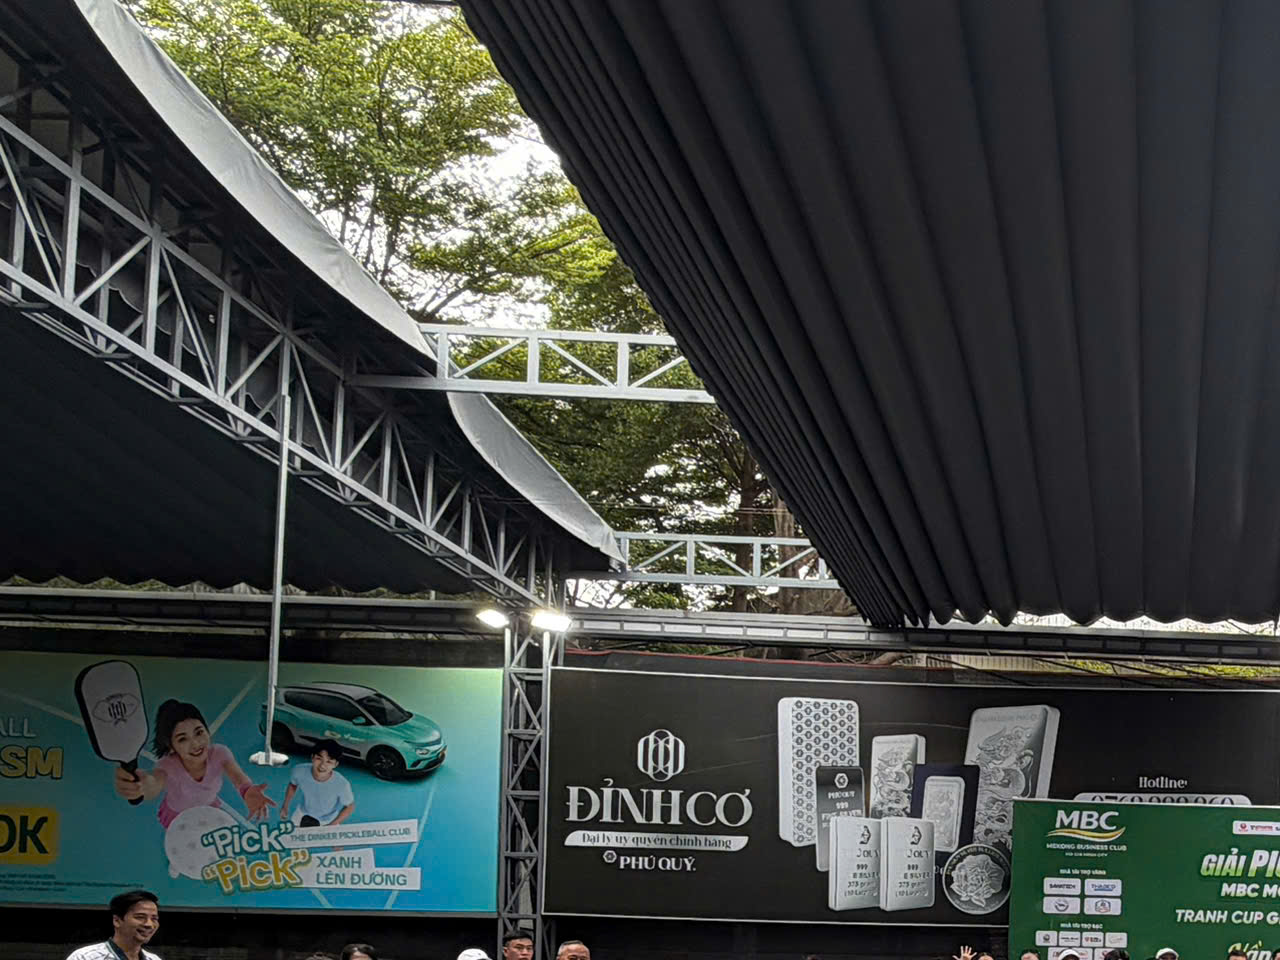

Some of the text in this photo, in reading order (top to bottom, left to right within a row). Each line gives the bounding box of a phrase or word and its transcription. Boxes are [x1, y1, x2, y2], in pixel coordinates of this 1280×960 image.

[1055, 810, 1119, 830] MBC
[339, 829, 386, 839] PICKLEBALL
[389, 827, 411, 836] CLUB
[317, 856, 362, 869] XANH
[1200, 848, 1247, 877] GIẢI
[316, 869, 408, 886] LÊN ĐƯỜNG
[1221, 883, 1259, 898] MBC
[1175, 909, 1228, 924] TRANH
[1231, 910, 1264, 925] CUP
